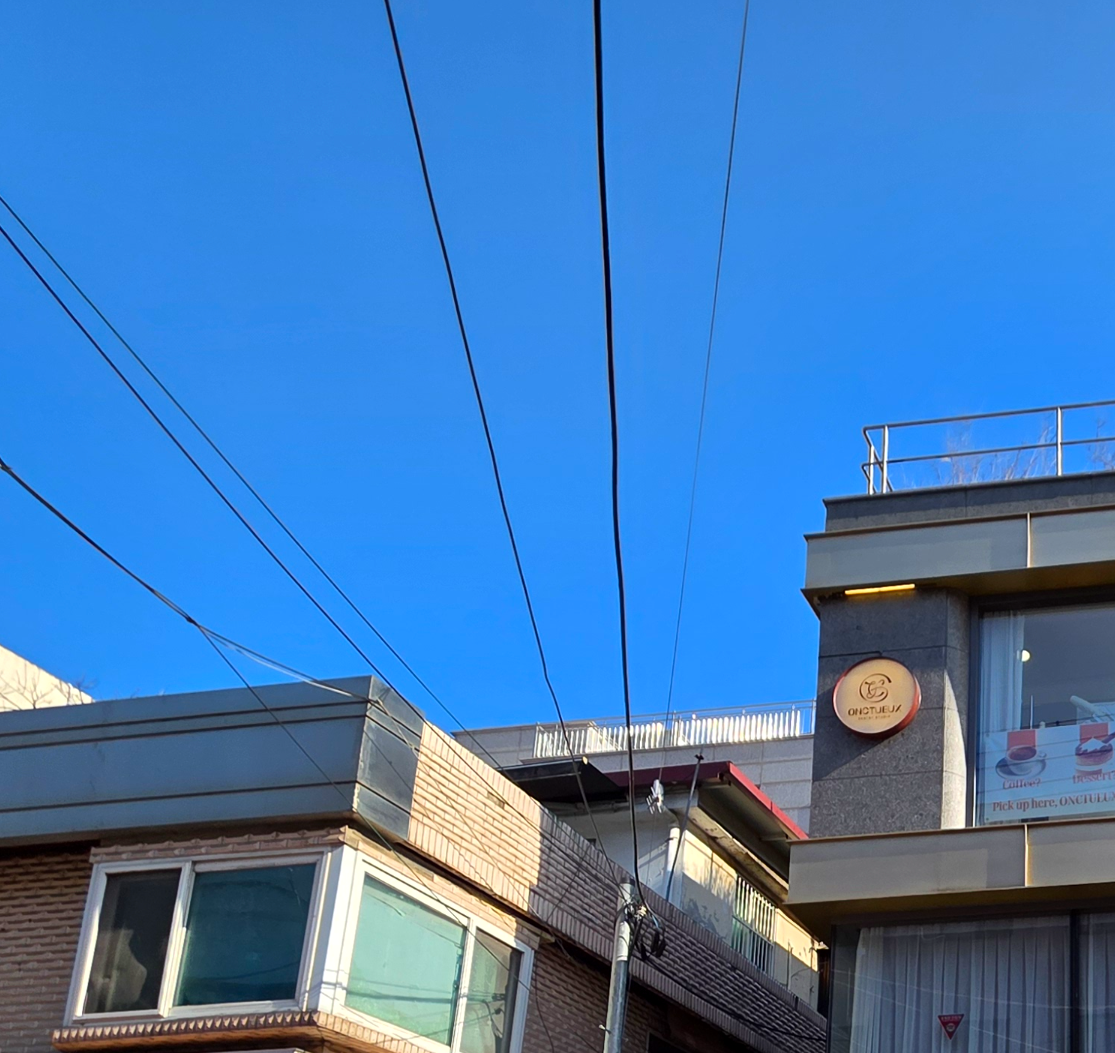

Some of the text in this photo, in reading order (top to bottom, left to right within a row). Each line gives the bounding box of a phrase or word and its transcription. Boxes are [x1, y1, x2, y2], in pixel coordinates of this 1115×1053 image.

[848, 704, 902, 717] ONCTUEUX
[1003, 778, 1042, 790] Coffee?
[993, 799, 1014, 812] Pick
[1016, 800, 1030, 812] up
[1031, 797, 1058, 809] here,
